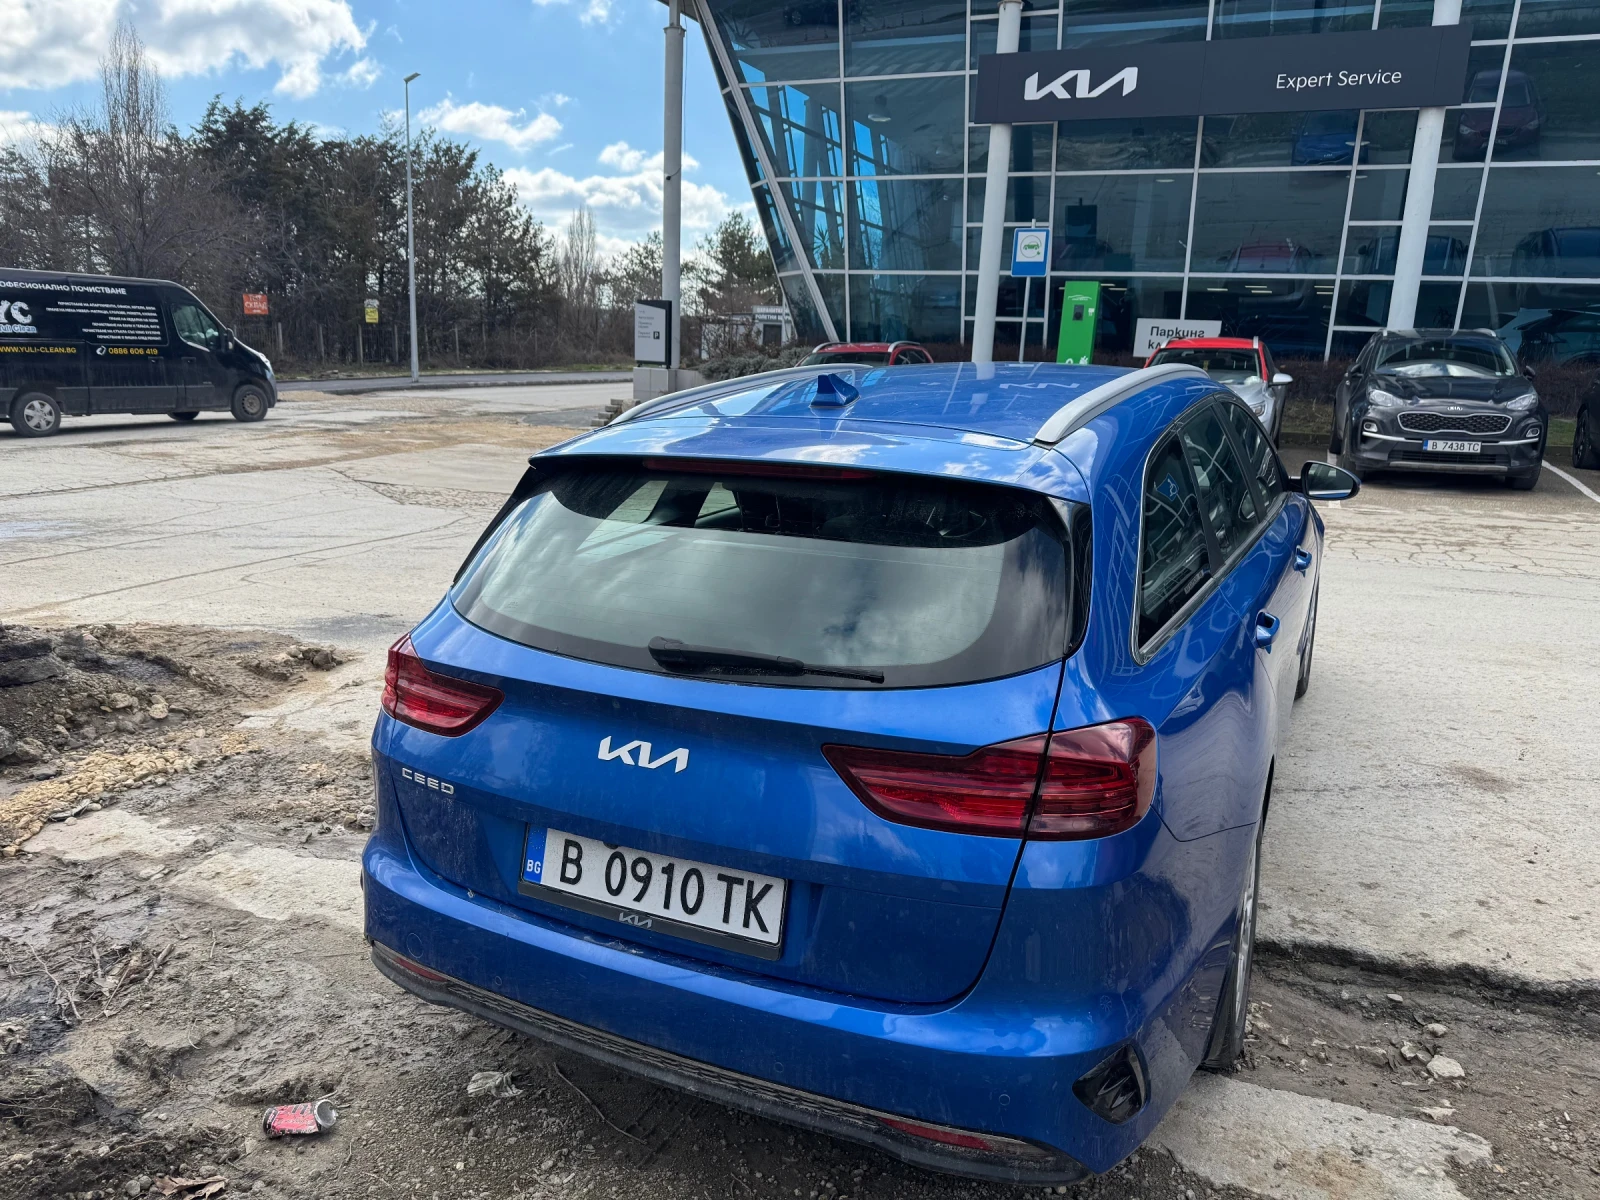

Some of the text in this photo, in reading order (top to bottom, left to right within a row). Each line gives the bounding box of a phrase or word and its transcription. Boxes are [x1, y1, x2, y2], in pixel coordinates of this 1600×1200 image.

[1024, 66, 1138, 100] KIA
[1276, 69, 1402, 92] Expert Service
[71, 285, 127, 295] ПОЧИСТВАНЕ
[1150, 326, 1205, 338] Паркинг
[145, 347, 158, 355] 419
[1442, 442, 1465, 451] 7438
[598, 736, 689, 773] KIA
[402, 767, 454, 795] CEED
[526, 859, 542, 874] BG
[560, 839, 774, 933] B 0910 TK
